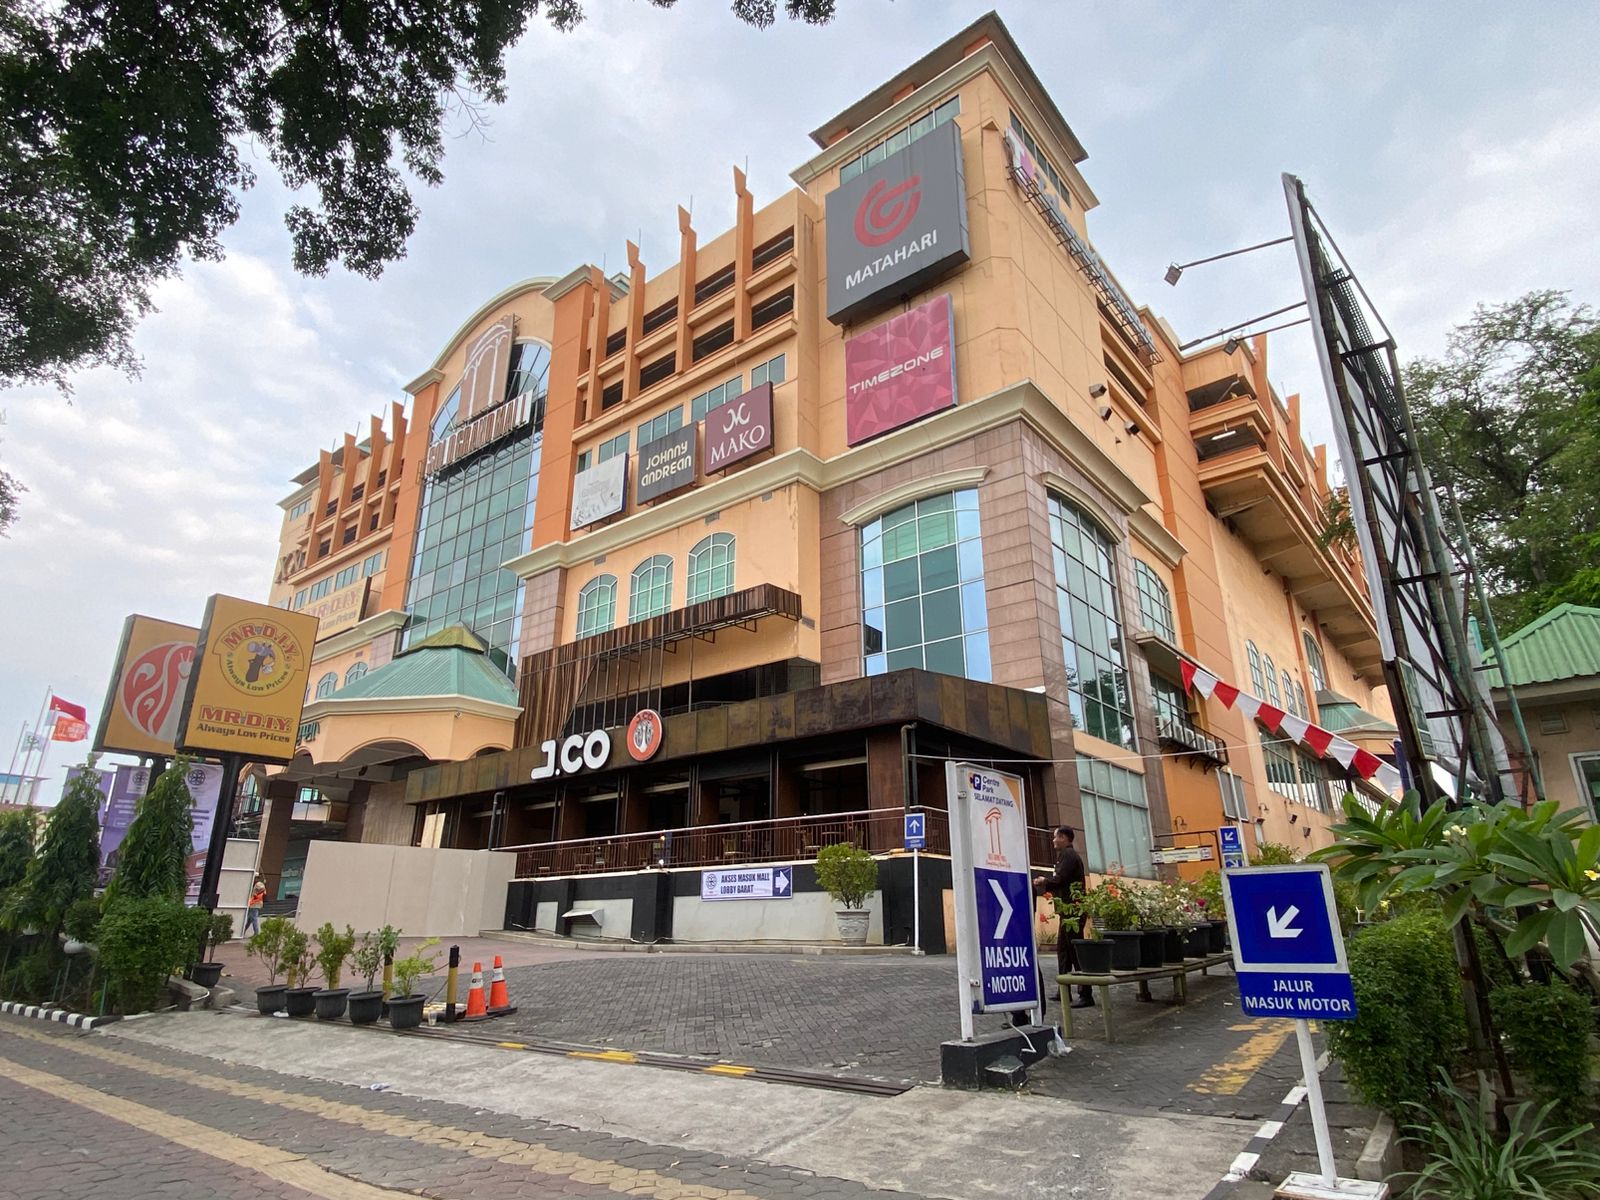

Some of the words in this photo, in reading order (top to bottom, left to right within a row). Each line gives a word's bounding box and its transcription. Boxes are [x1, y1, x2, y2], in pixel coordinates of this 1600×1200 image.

[845, 229, 937, 289] MATAHARI
[849, 346, 944, 394] TIMEZONE
[646, 440, 688, 471] JOHNNY
[710, 424, 765, 465] MAKO
[641, 456, 692, 487] ANDREAN
[197, 722, 236, 737] Always
[237, 727, 258, 739] Low
[259, 730, 290, 743] Prices
[530, 728, 611, 780] J.CO
[982, 785, 994, 794] Park
[721, 874, 737, 883] AKSES
[738, 873, 756, 882] MASUK
[757, 872, 770, 881] MALL
[720, 885, 736, 895] LOBBY
[737, 884, 754, 893] BARAT
[985, 946, 1029, 969] MASUK
[991, 975, 1026, 994] MOTOR
[1273, 980, 1315, 993] JALUR
[1245, 996, 1294, 1010] MASUK
[1297, 998, 1351, 1012] MOTOR
